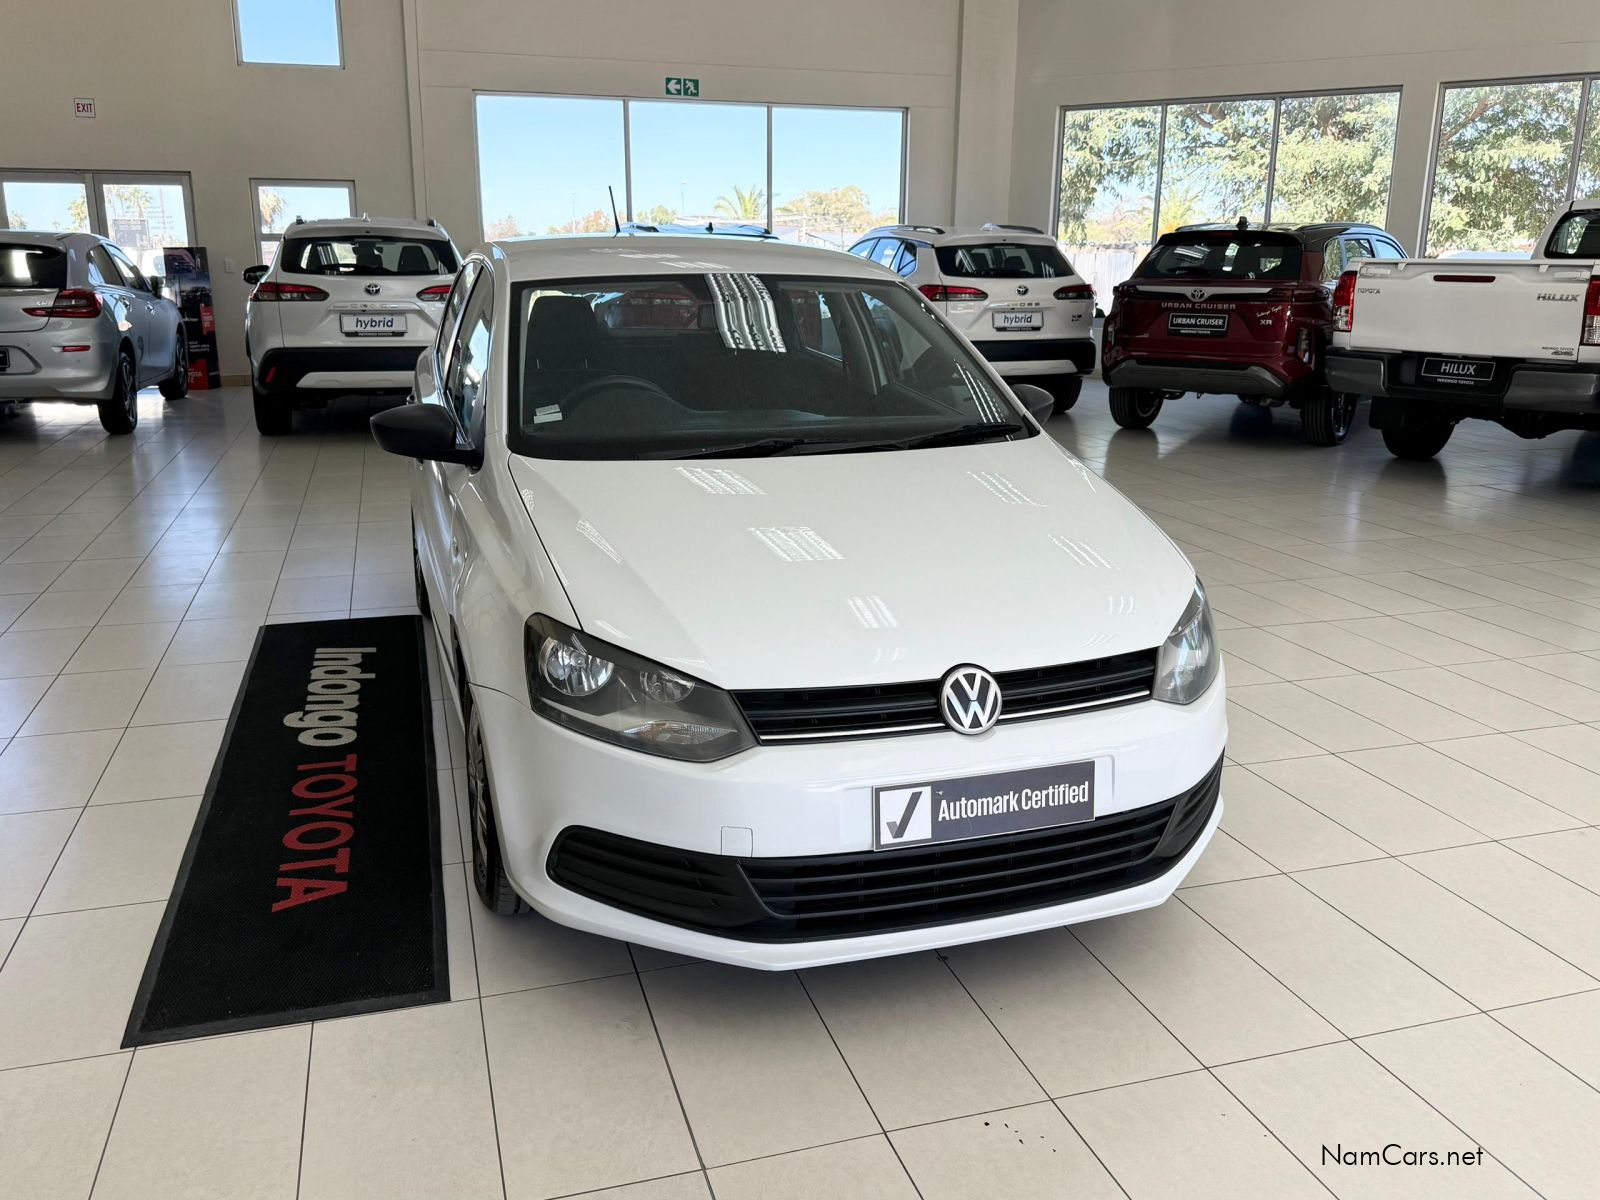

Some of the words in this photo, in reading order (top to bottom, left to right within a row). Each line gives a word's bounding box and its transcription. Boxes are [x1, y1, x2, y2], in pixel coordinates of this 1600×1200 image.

[76, 102, 92, 113] EXIT
[1536, 293, 1580, 302] HILUX
[355, 317, 394, 329] hybrid
[1003, 314, 1033, 325] hybrid
[1173, 317, 1195, 325] URBAN
[1196, 318, 1224, 326] CRUISER
[1440, 362, 1477, 375] HILUX
[283, 647, 377, 747] Indongo
[938, 790, 1019, 822] Automark
[1021, 781, 1089, 811] Certified
[271, 753, 358, 913] TOYOTA
